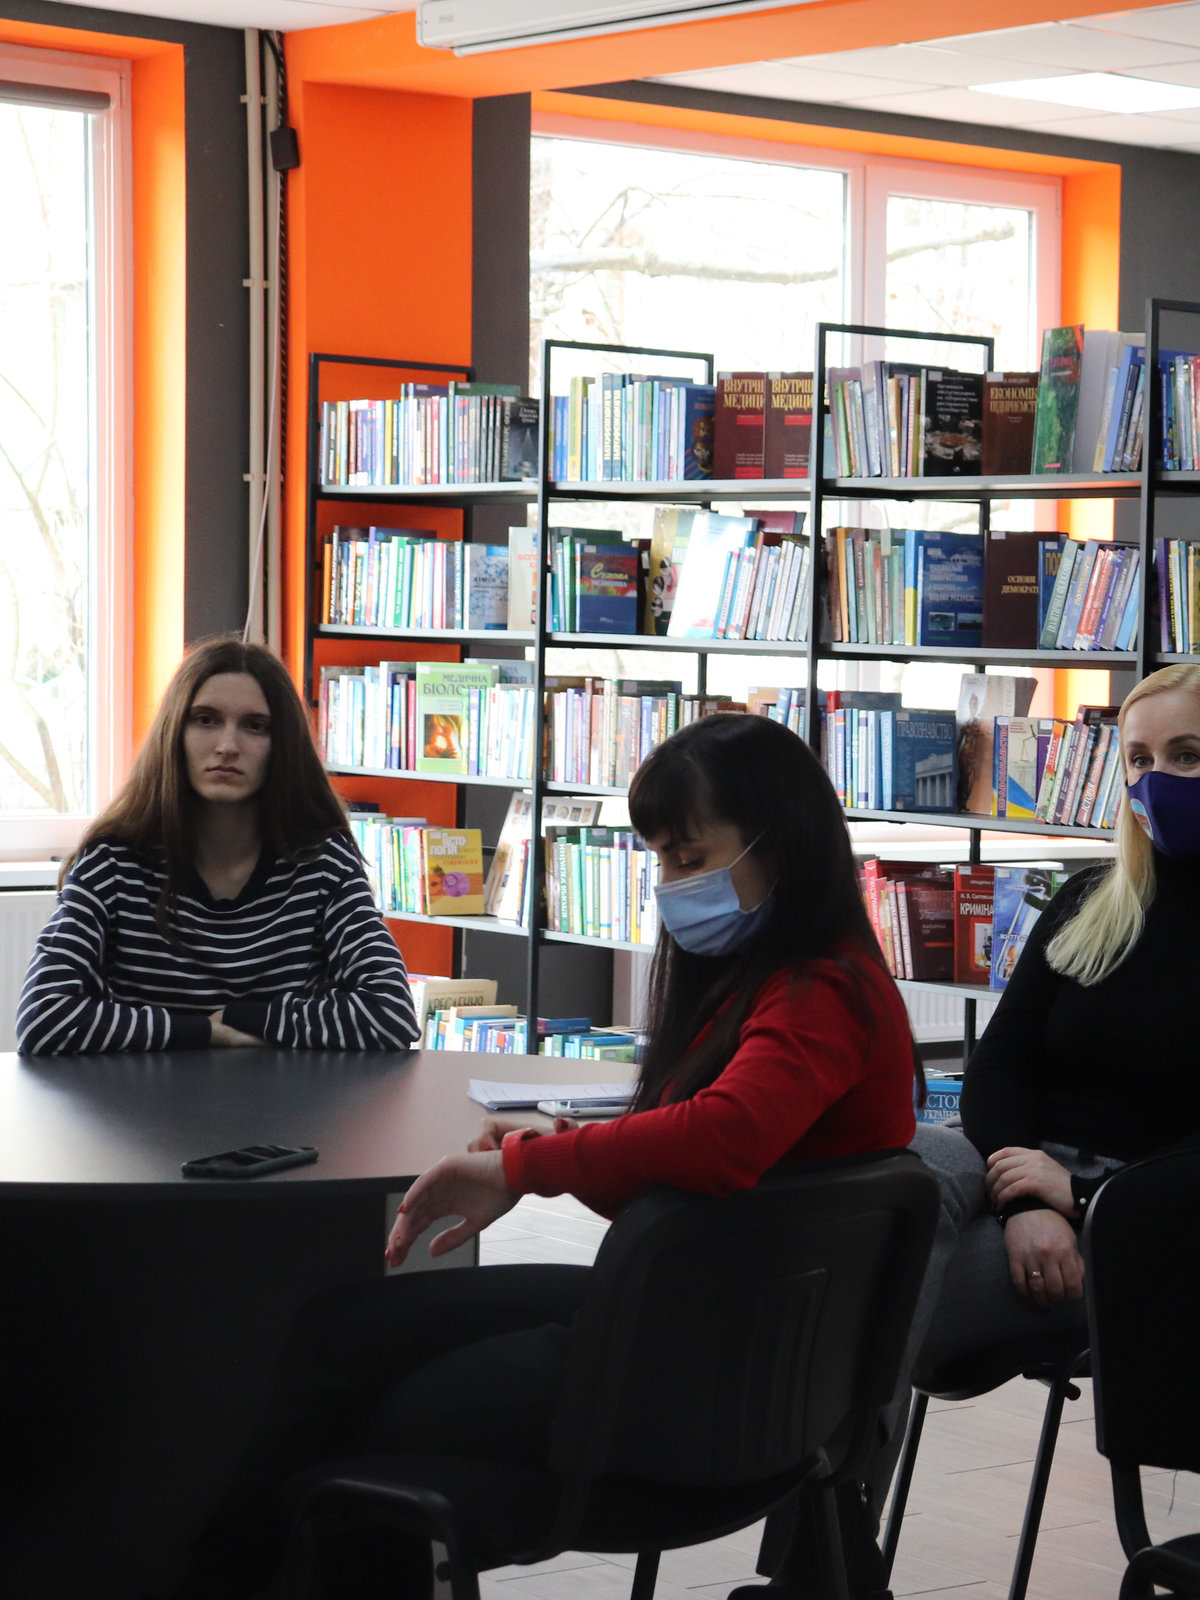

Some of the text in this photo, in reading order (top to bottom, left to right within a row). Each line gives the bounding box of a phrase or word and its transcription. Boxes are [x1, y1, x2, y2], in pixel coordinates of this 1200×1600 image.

[442, 673, 488, 683] МЕДИЧНА
[423, 683, 488, 696] БІОЛОГІЯ
[897, 721, 953, 740] ПРАВОЗНАВСТВО
[1080, 781, 1095, 812] ІСТОРІЯ
[559, 843, 568, 918] ІСТОРІЯ УКРАЇНИ
[960, 903, 994, 916] КРИМІНА
[927, 1094, 961, 1109] СТО
